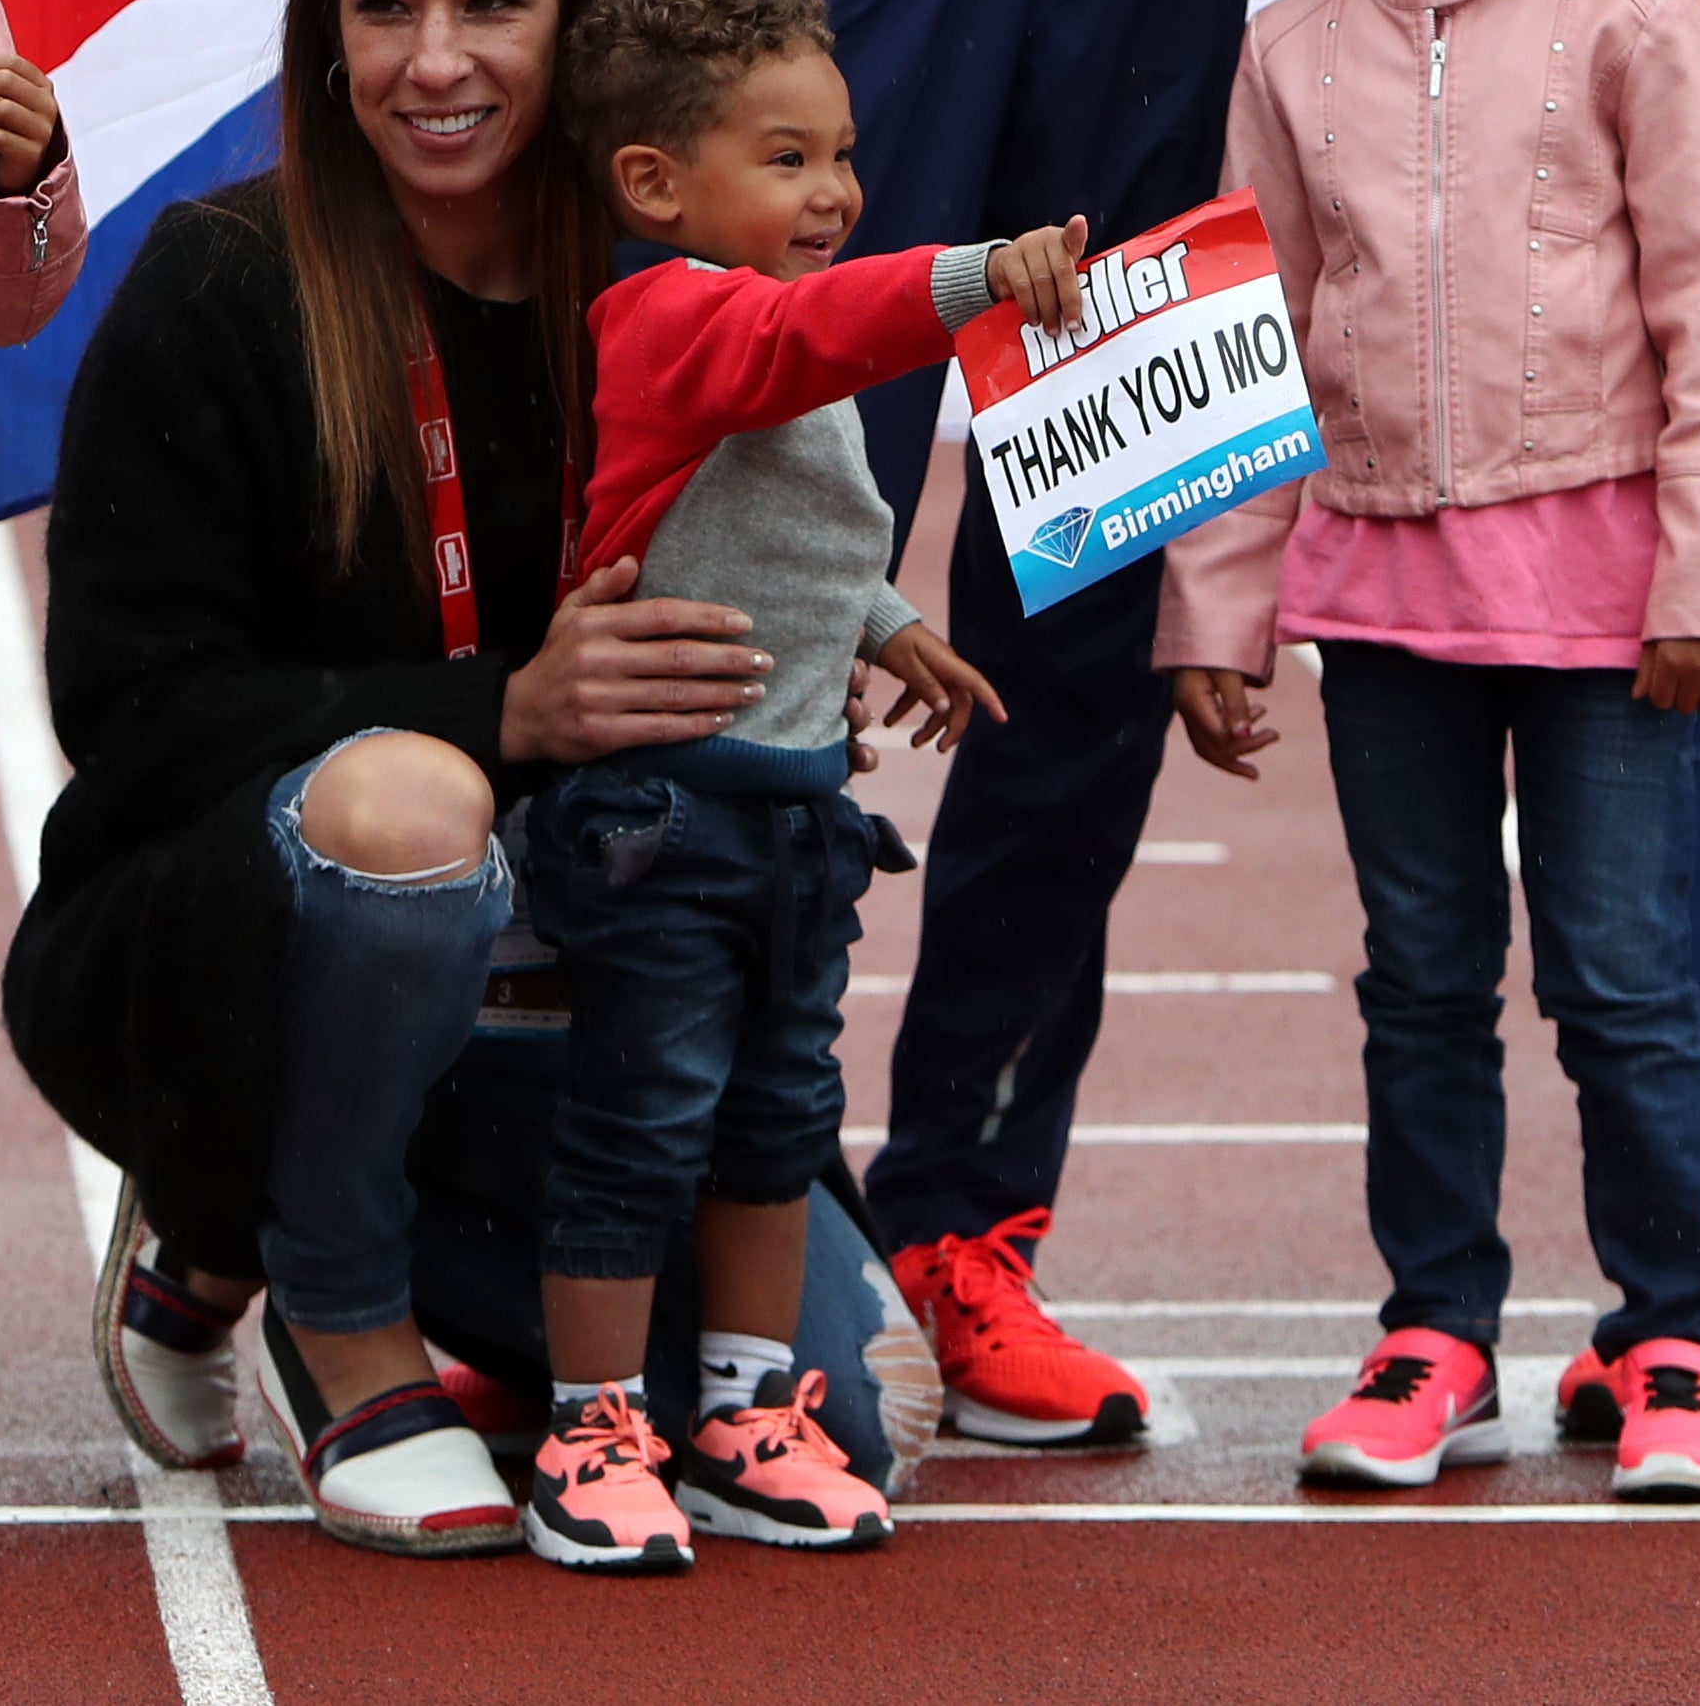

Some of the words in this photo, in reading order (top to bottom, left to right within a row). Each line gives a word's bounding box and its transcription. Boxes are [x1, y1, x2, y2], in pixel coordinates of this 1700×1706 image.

[992, 383, 1128, 509] THANK
[1119, 338, 1211, 437] YOU
[1215, 312, 1290, 395] MO
[1099, 428, 1312, 552] Birmingham
